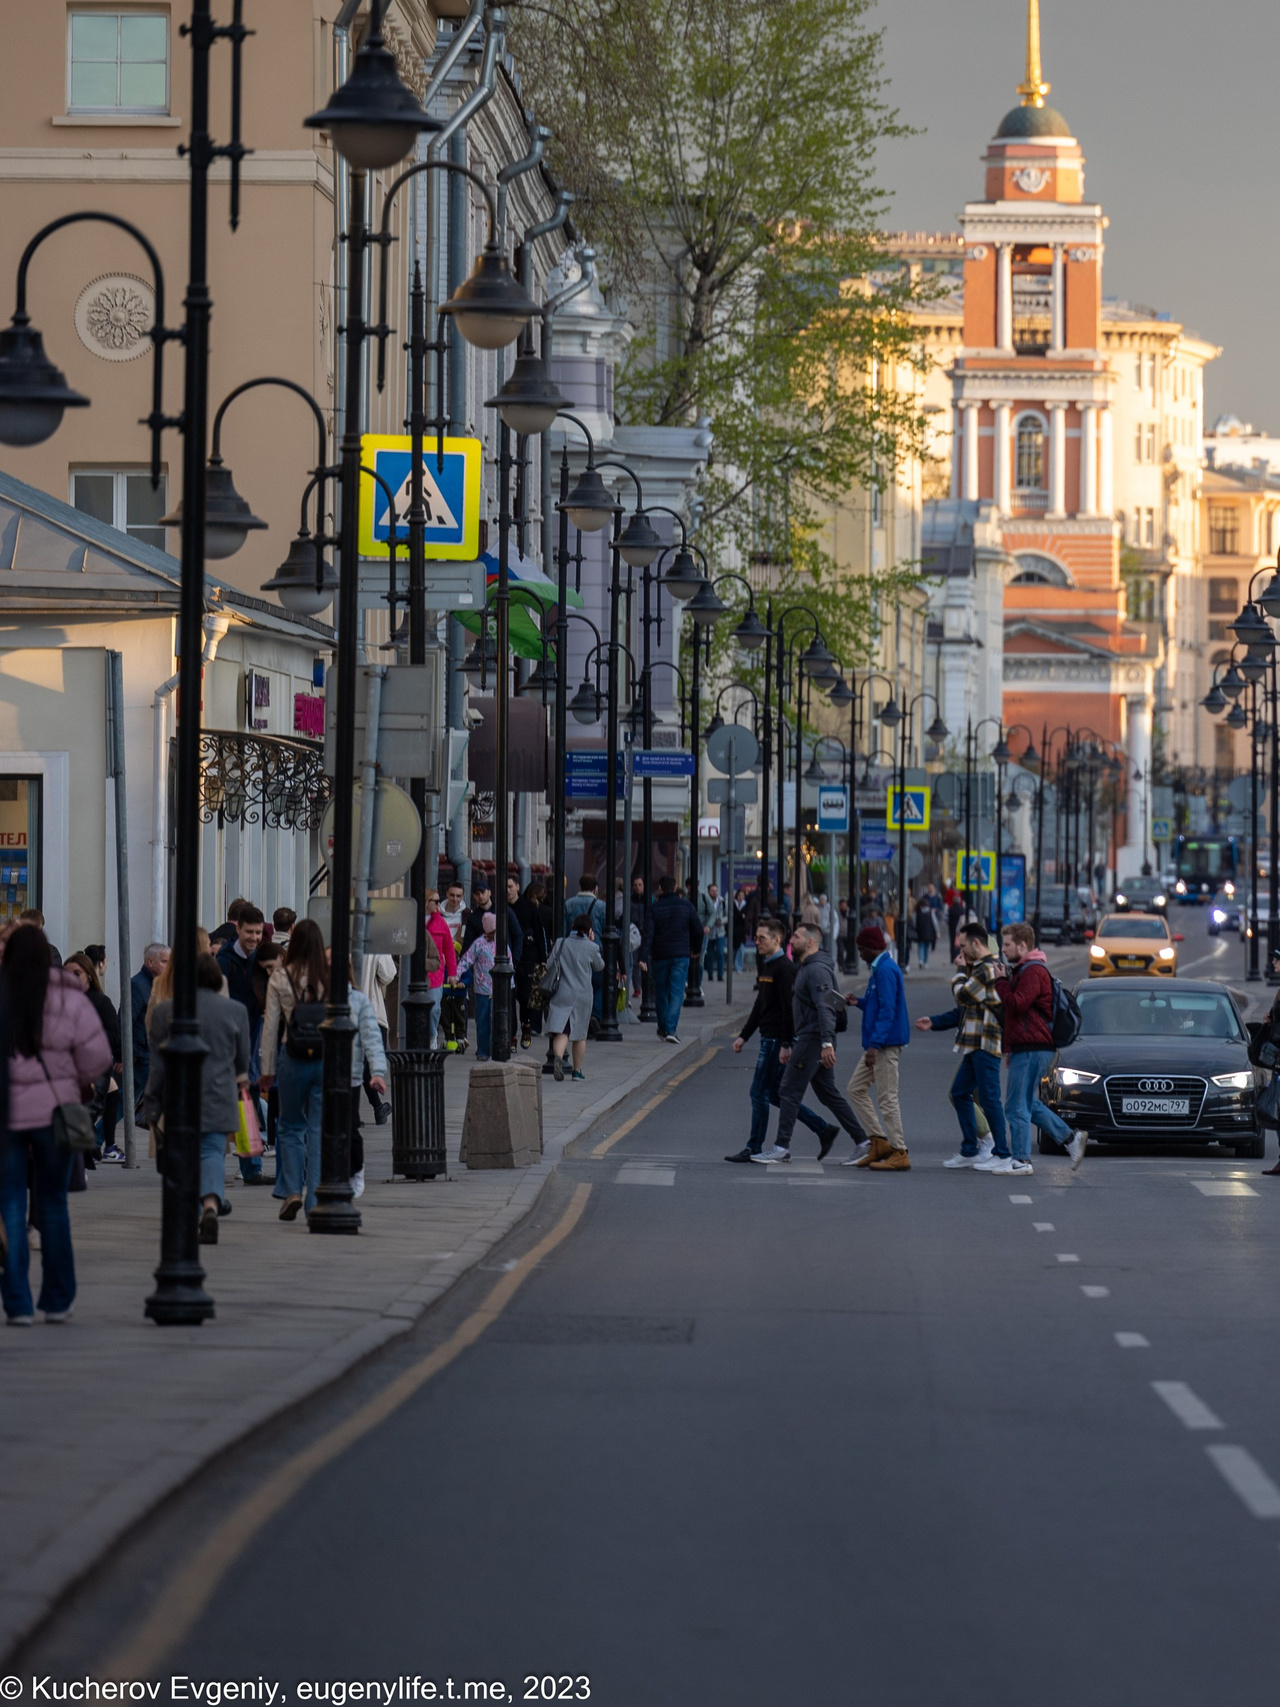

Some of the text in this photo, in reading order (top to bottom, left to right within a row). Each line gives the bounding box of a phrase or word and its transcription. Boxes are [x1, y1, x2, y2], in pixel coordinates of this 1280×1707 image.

[0, 832, 27, 846] ТЕЛ
[1125, 1100, 1186, 1112] О092МС 797
